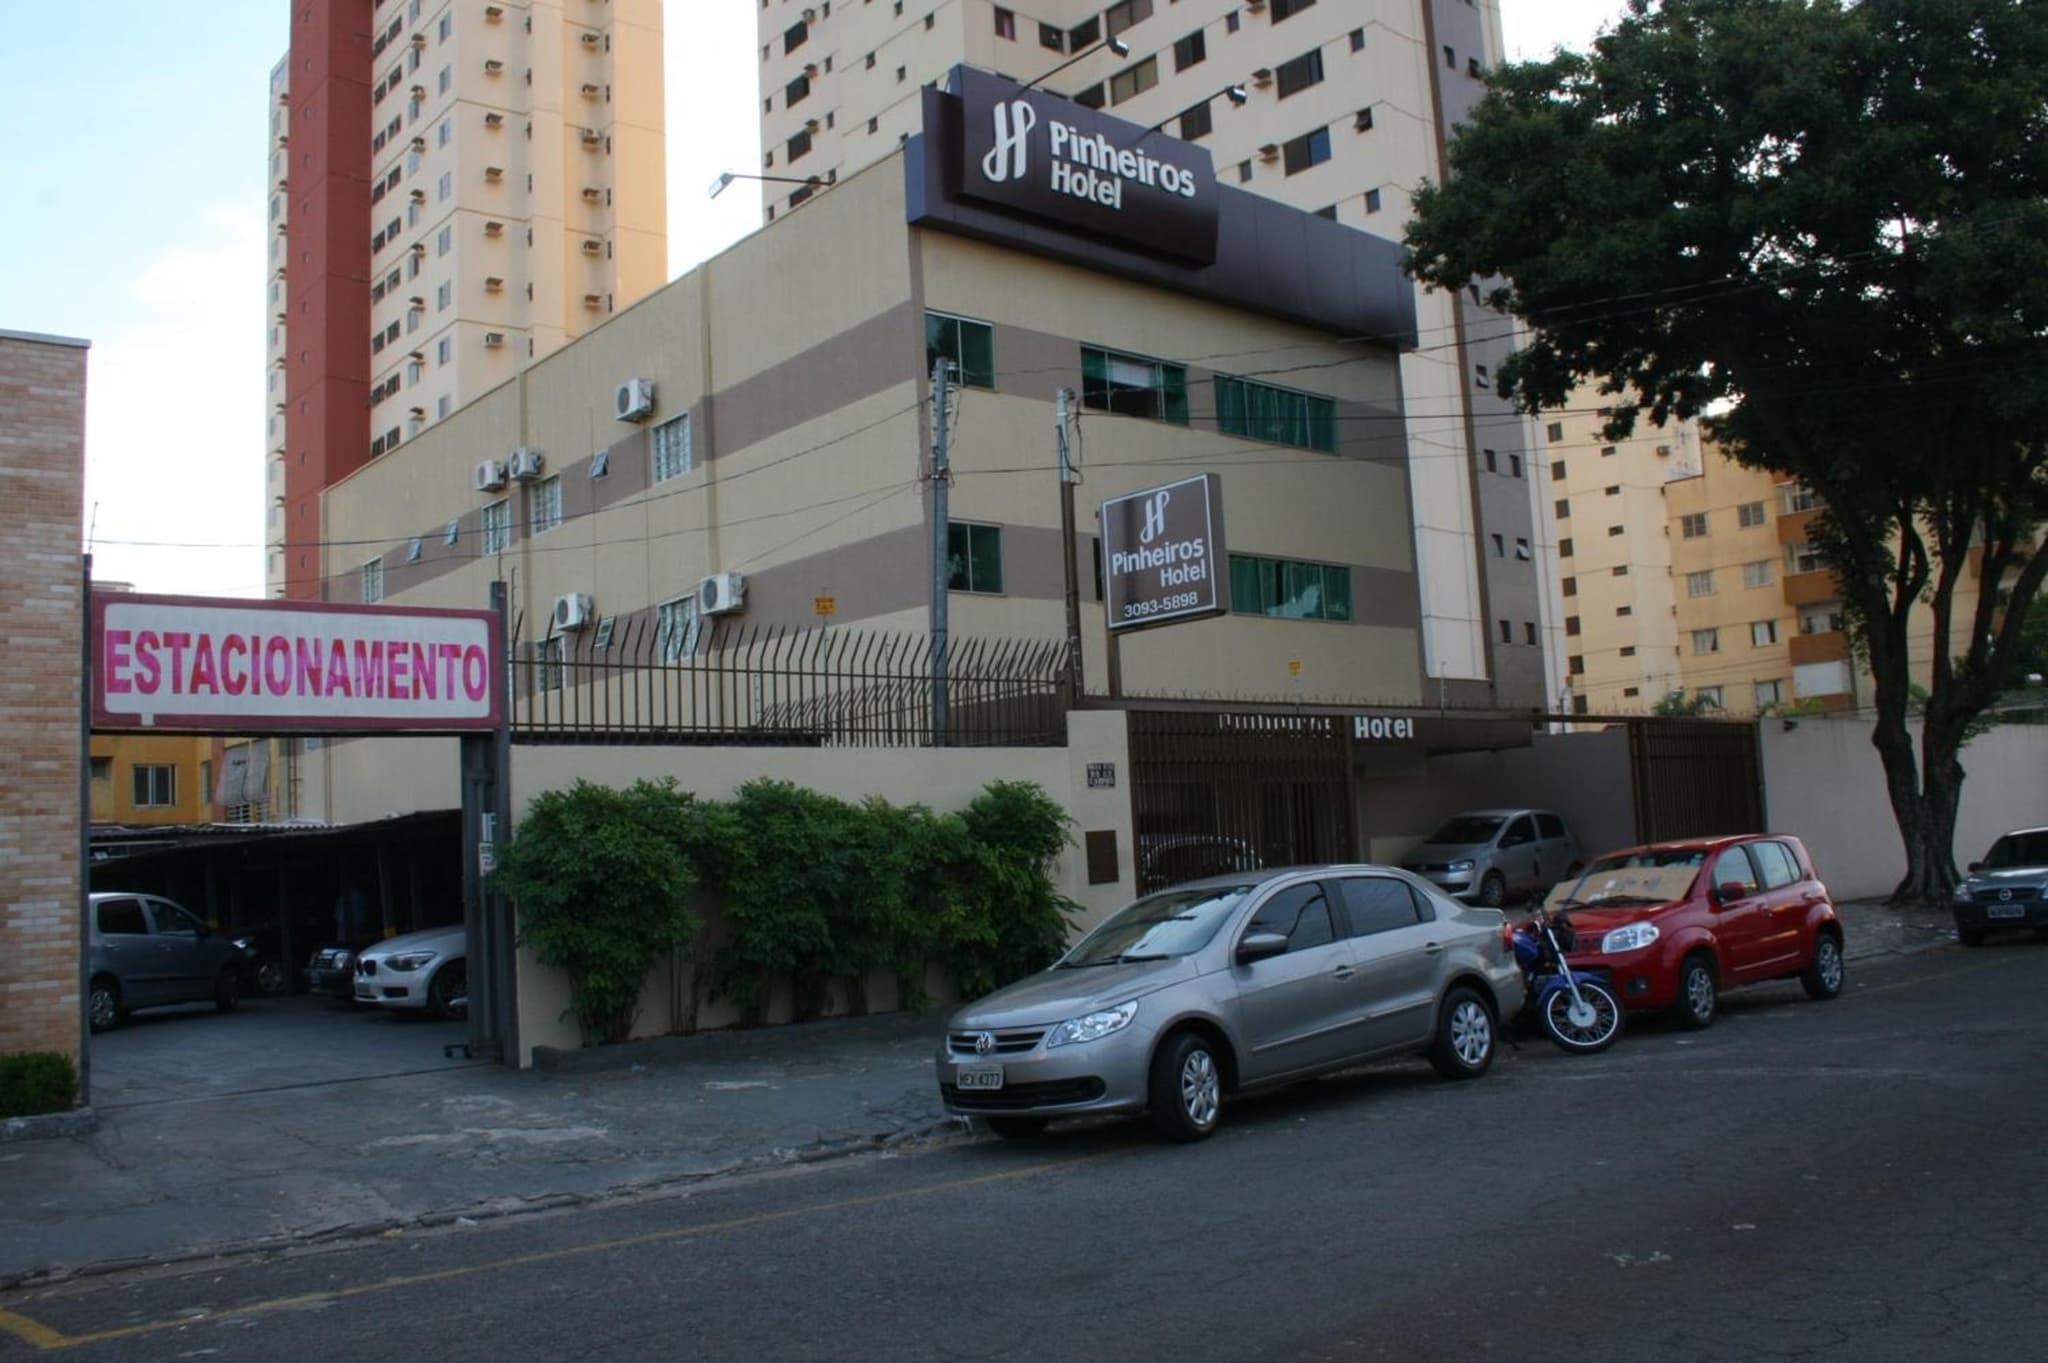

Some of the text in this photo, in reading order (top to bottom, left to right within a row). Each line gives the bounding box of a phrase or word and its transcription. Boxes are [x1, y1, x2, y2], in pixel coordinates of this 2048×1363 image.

[1049, 120, 1196, 198] Pinheiros
[1051, 160, 1122, 209] Hotel
[1111, 538, 1204, 576] Pinheiros
[1160, 558, 1206, 588] Hotel
[1124, 591, 1198, 618] 3093-5898
[106, 629, 488, 702] ESTACIONAMENTO
[1354, 716, 1414, 739] Hotel
